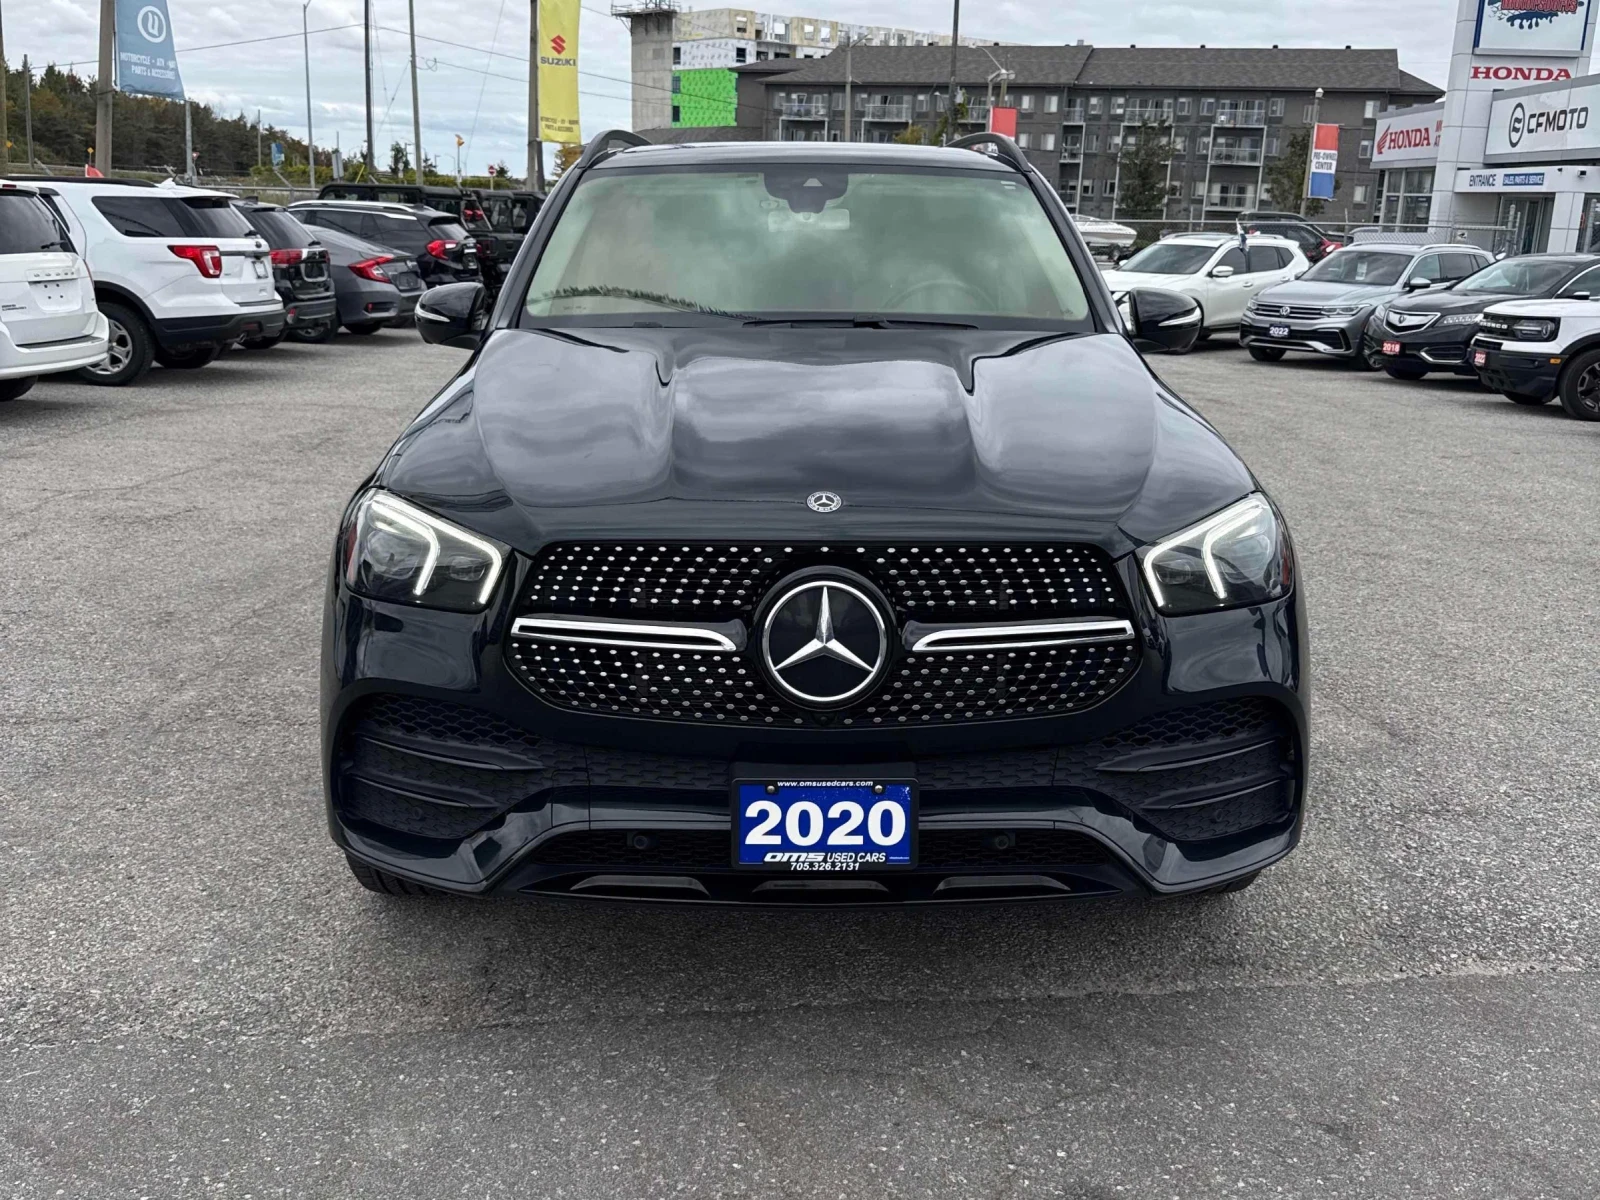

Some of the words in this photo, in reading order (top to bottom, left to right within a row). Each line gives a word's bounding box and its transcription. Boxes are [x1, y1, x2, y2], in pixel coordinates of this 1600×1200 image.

[540, 56, 576, 67] SUZUKI
[1470, 66, 1572, 81] HONDA
[1527, 106, 1589, 134] CFMOTO
[1387, 127, 1431, 150] HONDA
[1315, 161, 1333, 170] CENTER
[1469, 174, 1497, 187] ENTRANCE
[1269, 326, 1289, 336] 2022
[1382, 342, 1400, 353] 2018
[745, 800, 906, 846] 2020
[827, 852, 856, 863] USED
[857, 852, 886, 863] CARS
[790, 862, 859, 871] 705.326.2131
